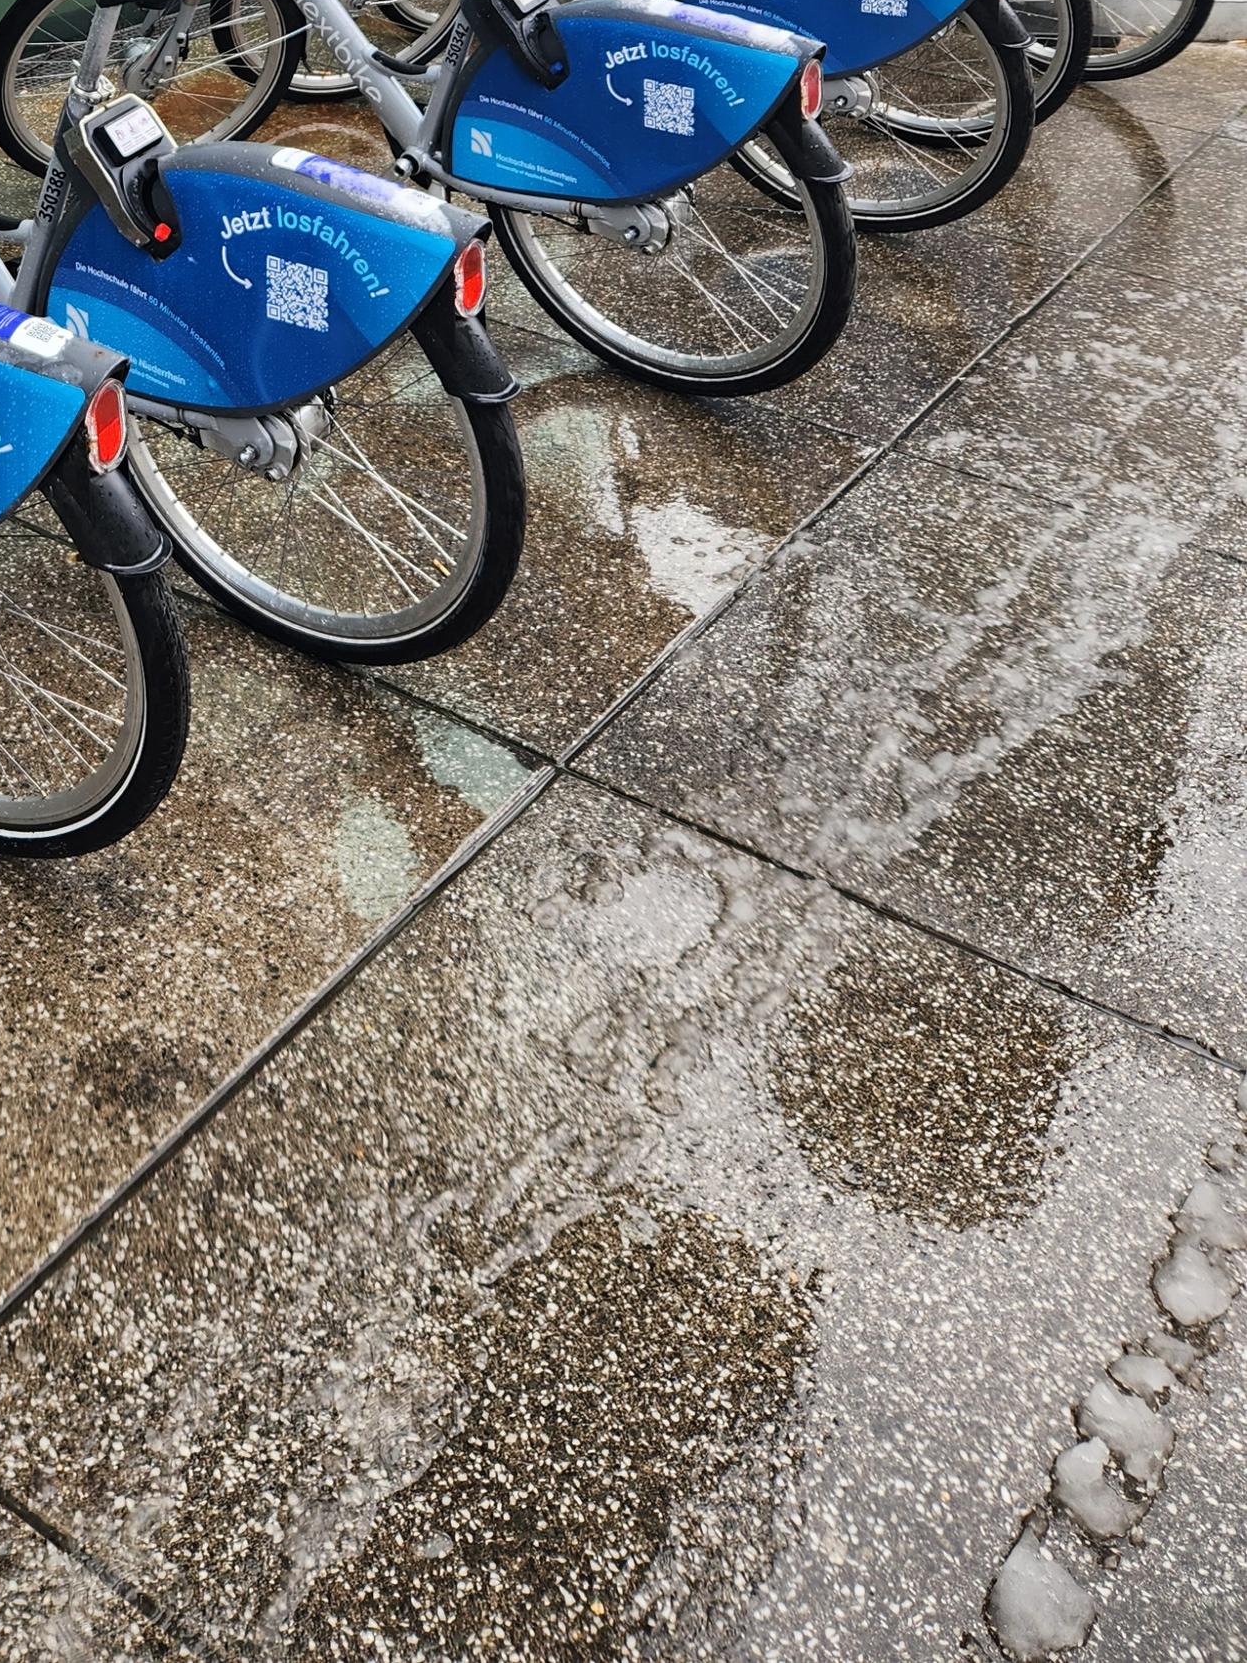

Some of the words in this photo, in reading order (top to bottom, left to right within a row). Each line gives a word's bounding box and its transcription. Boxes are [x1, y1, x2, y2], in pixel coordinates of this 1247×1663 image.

[710, 0, 747, 11] Hochschule
[763, 10, 772, 18] 60
[445, 22, 470, 66] 350342
[605, 42, 648, 69] Jetzt
[651, 40, 745, 107] losfahren!
[479, 94, 490, 104] Die
[490, 97, 527, 114] Hochschule
[543, 116, 553, 126] 60
[553, 120, 580, 143] Minuten
[495, 153, 536, 171] Hochschule
[536, 165, 578, 184] Niederrhein
[39, 168, 66, 223] 350388
[220, 207, 272, 239] Jetzt
[276, 205, 390, 299] losfahren!
[75, 261, 86, 273] Die
[87, 265, 129, 289] Hochschule
[129, 283, 148, 300] fährt
[148, 295, 159, 307] 60
[159, 302, 189, 331] Minuten
[189, 327, 226, 371] kostenlos.
[138, 358, 186, 386] Niederrhein
